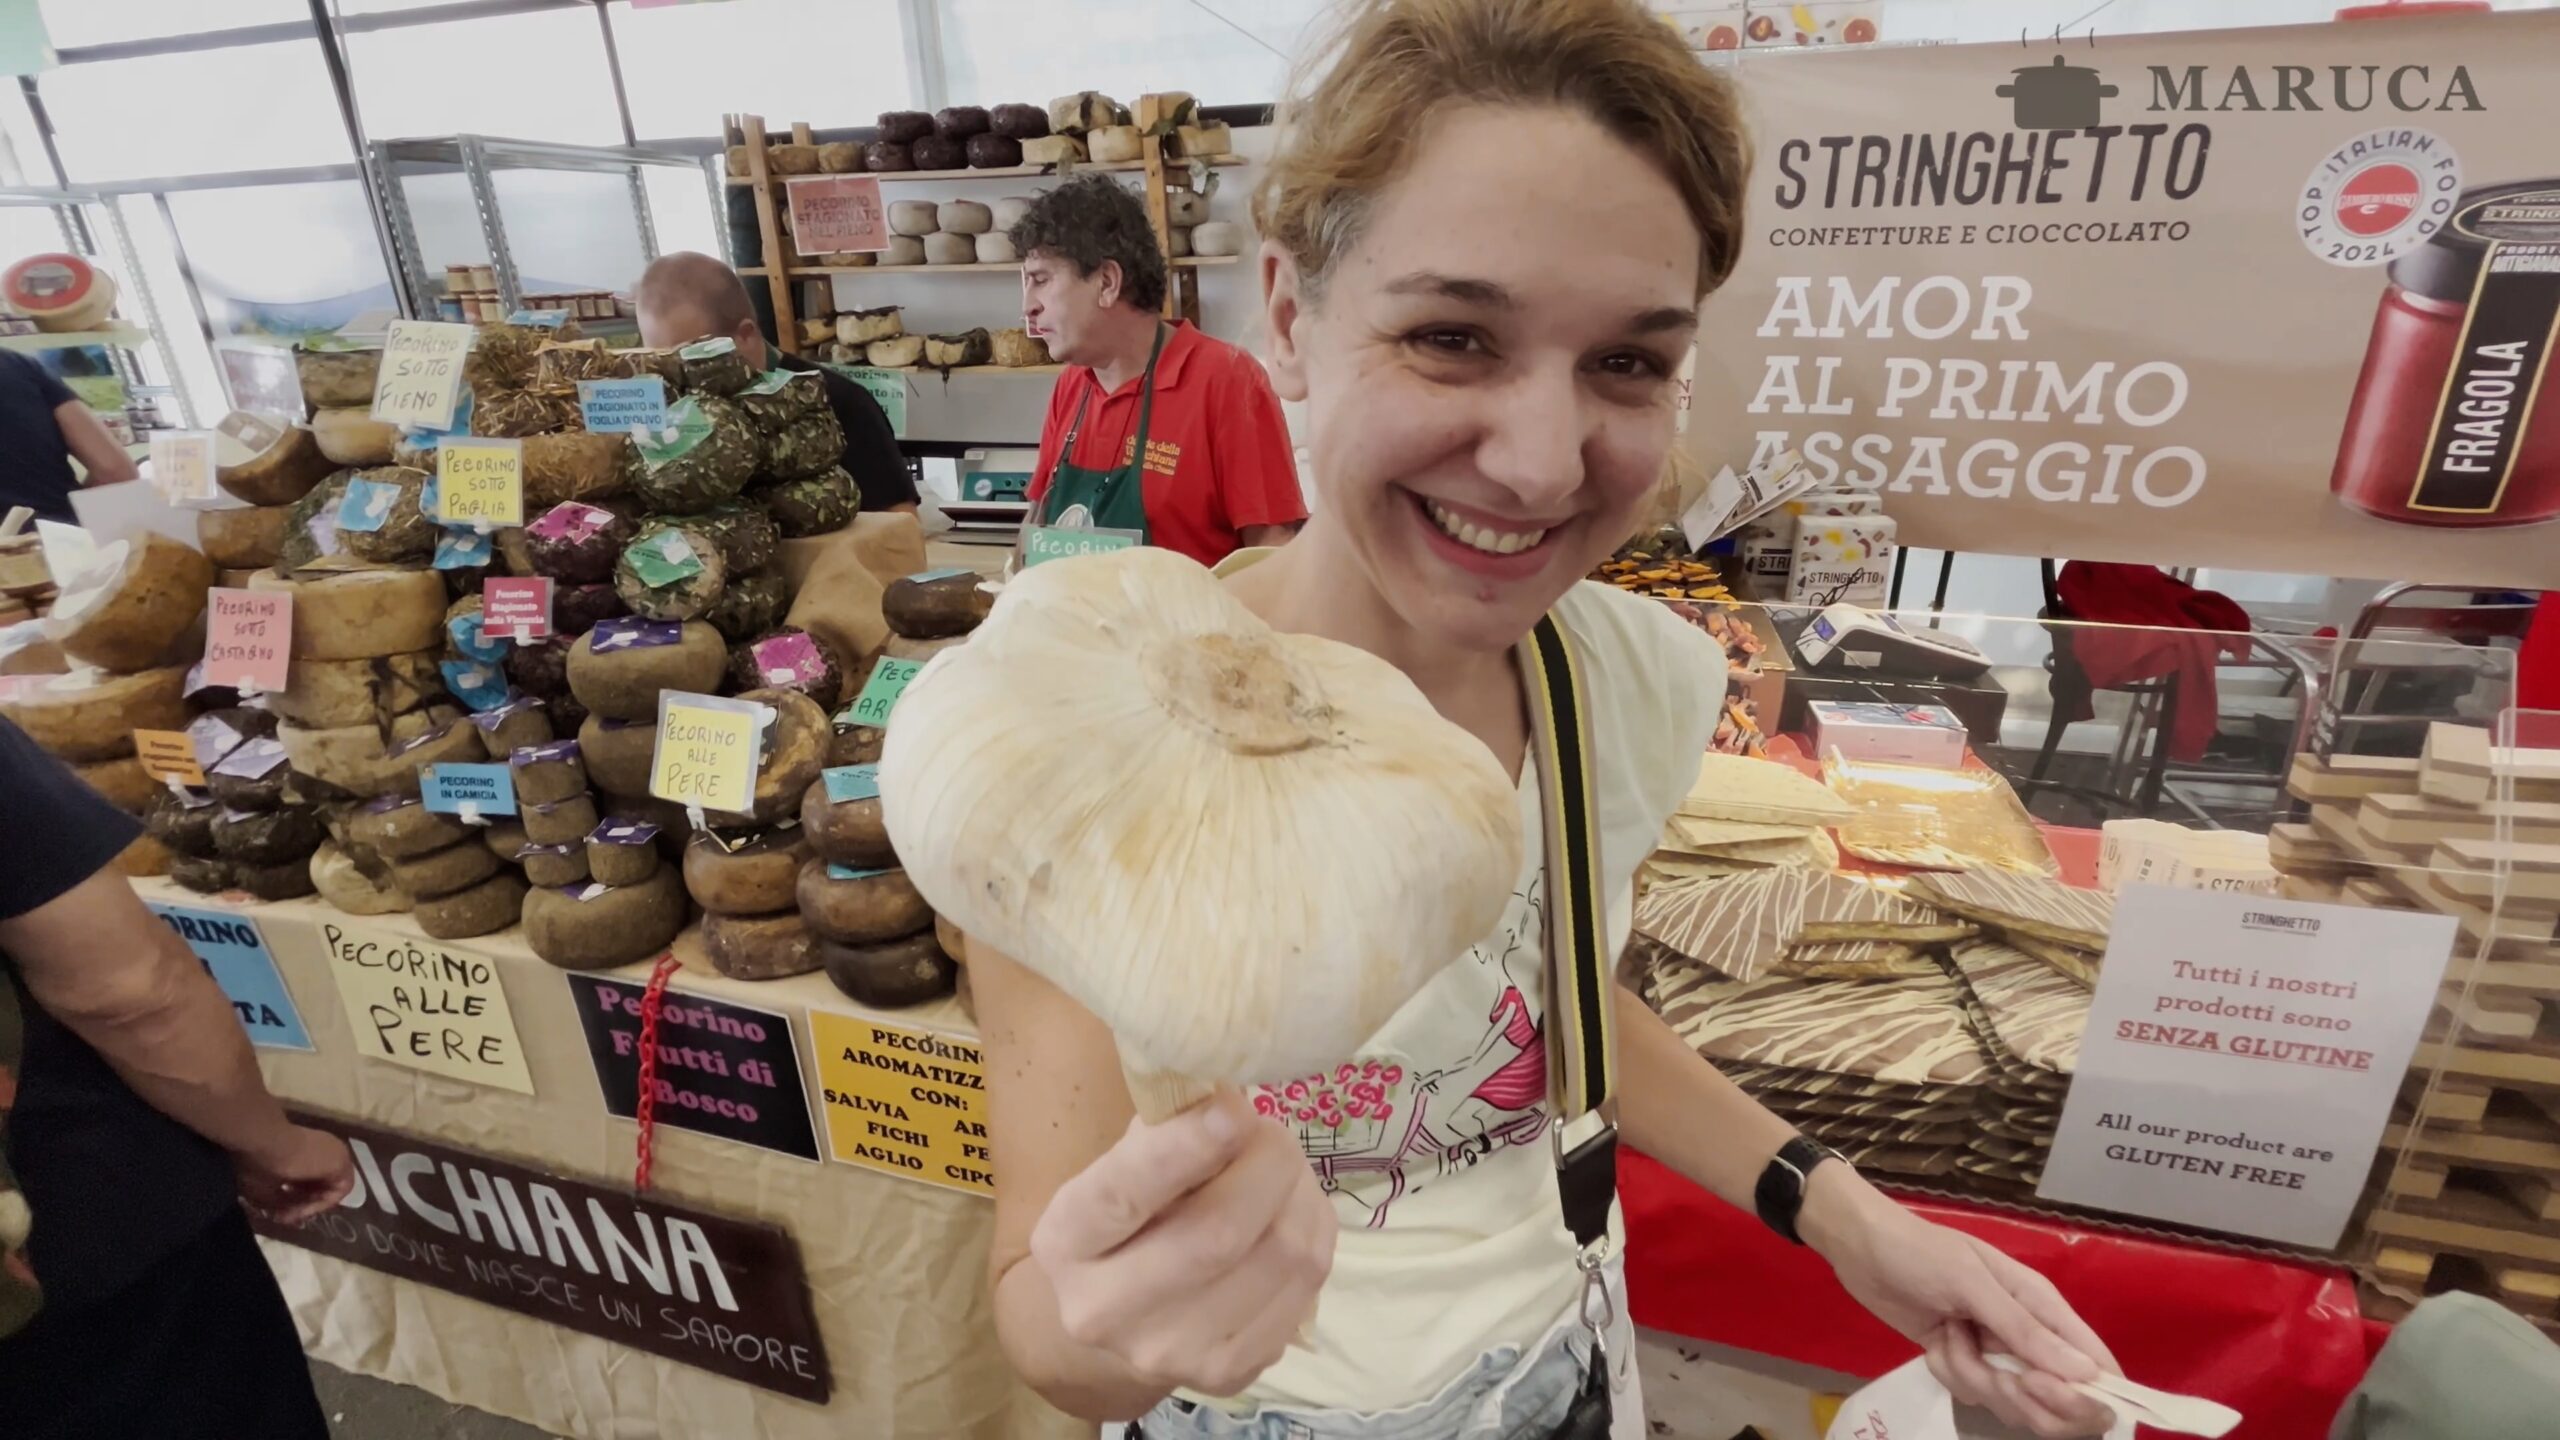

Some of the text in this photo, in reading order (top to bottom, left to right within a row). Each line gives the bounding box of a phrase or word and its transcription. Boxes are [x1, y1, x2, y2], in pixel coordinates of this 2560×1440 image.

[1775, 122, 2212, 210] STRINGHETTO
[2302, 130, 2457, 238] TOP ITALIAN FOOD
[1769, 220, 2191, 247] CONFETTURE E CIOCCOLATO
[2327, 242, 2395, 262] 2024
[1756, 275, 2033, 340] AMOR
[389, 327, 460, 352] PECORINO
[396, 357, 449, 377] SOTTO
[378, 382, 438, 412] FIENO
[595, 387, 645, 399] PECORINO
[1746, 355, 1854, 415] AL
[1876, 357, 2189, 427] PRIMO
[587, 401, 647, 414] STAGIONATO
[588, 414, 623, 427] FOGLIA
[2443, 340, 2529, 473] FRAGOLA
[444, 449, 516, 474] PECORINO
[469, 476, 507, 491] SOTTO
[448, 492, 506, 518] PAGLIA
[1031, 531, 1119, 555] PECORIN
[1758, 556, 1791, 569] STRI
[216, 595, 276, 616] PECORINO
[665, 712, 736, 746] PECORINO
[687, 748, 717, 766] ALLE
[439, 776, 495, 788] PECORINO
[666, 762, 721, 797] PERE
[440, 789, 498, 801] IN CAMICIA
[2173, 959, 2358, 1001] Tutti i nostri
[393, 986, 487, 1017] ALLE
[2153, 995, 2352, 1032] prodotti sono
[369, 1004, 504, 1065] PERE
[872, 1029, 984, 1065] PECORIN
[2116, 1019, 2374, 1071] SENZA GLUTINE
[738, 1059, 777, 1088] di
[842, 1047, 985, 1090] AROMATIZZ
[651, 1078, 758, 1123] Bosco
[824, 1088, 910, 1121] SALVIA
[910, 1087, 969, 1111] CON:
[867, 1120, 930, 1148] FICHI
[2096, 1112, 2334, 1163] All our product are
[854, 1143, 924, 1171] AGLIO
[2105, 1144, 2307, 1190] GLUTEN FREE
[340, 1137, 740, 1312] ICHIANA
[366, 1222, 456, 1273] DOVE
[464, 1254, 585, 1312] NASCE
[598, 1293, 641, 1329] UN
[659, 1307, 817, 1381] SAPORE
